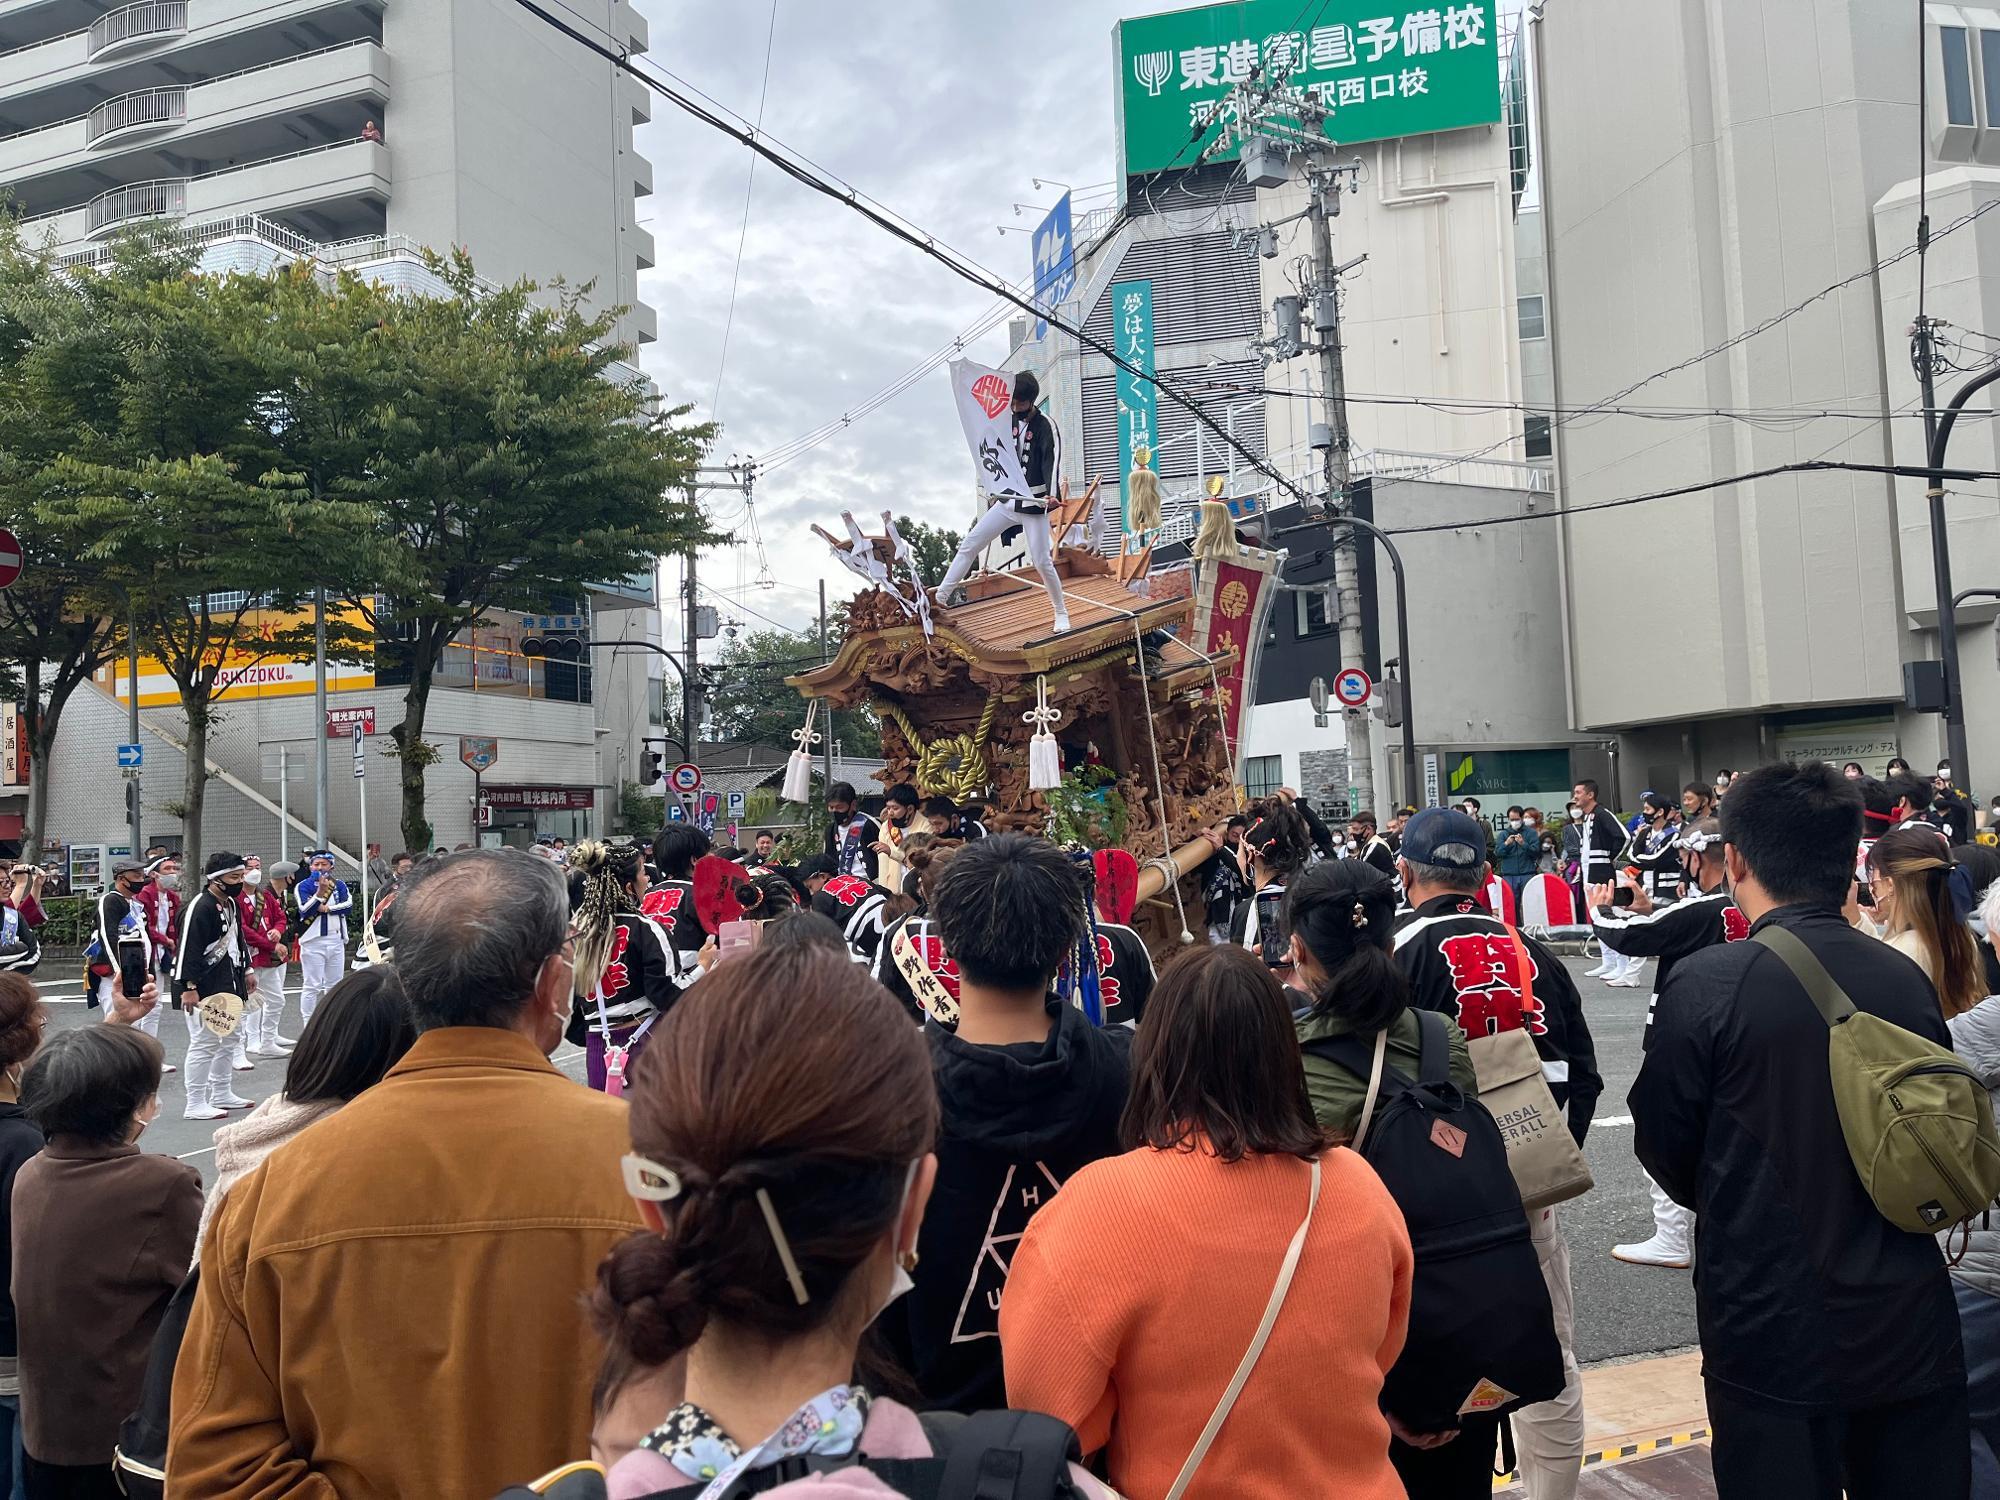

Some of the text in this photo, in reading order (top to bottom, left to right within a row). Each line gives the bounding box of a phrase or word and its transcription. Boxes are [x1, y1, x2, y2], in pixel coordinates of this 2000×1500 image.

[1179, 3, 1486, 90] 東進衛星予備校
[211, 666, 284, 686] ORIKIZOKU
[331, 708, 374, 723] 観光案内所
[5, 715, 15, 772] 居酒屋
[354, 724, 362, 754] P
[730, 793, 742, 808] P
[670, 806, 681, 819] P
[1495, 1103, 1540, 1128] ERSAL
[1500, 1118, 1548, 1142] ERALL
[1021, 1185, 1040, 1208] H
